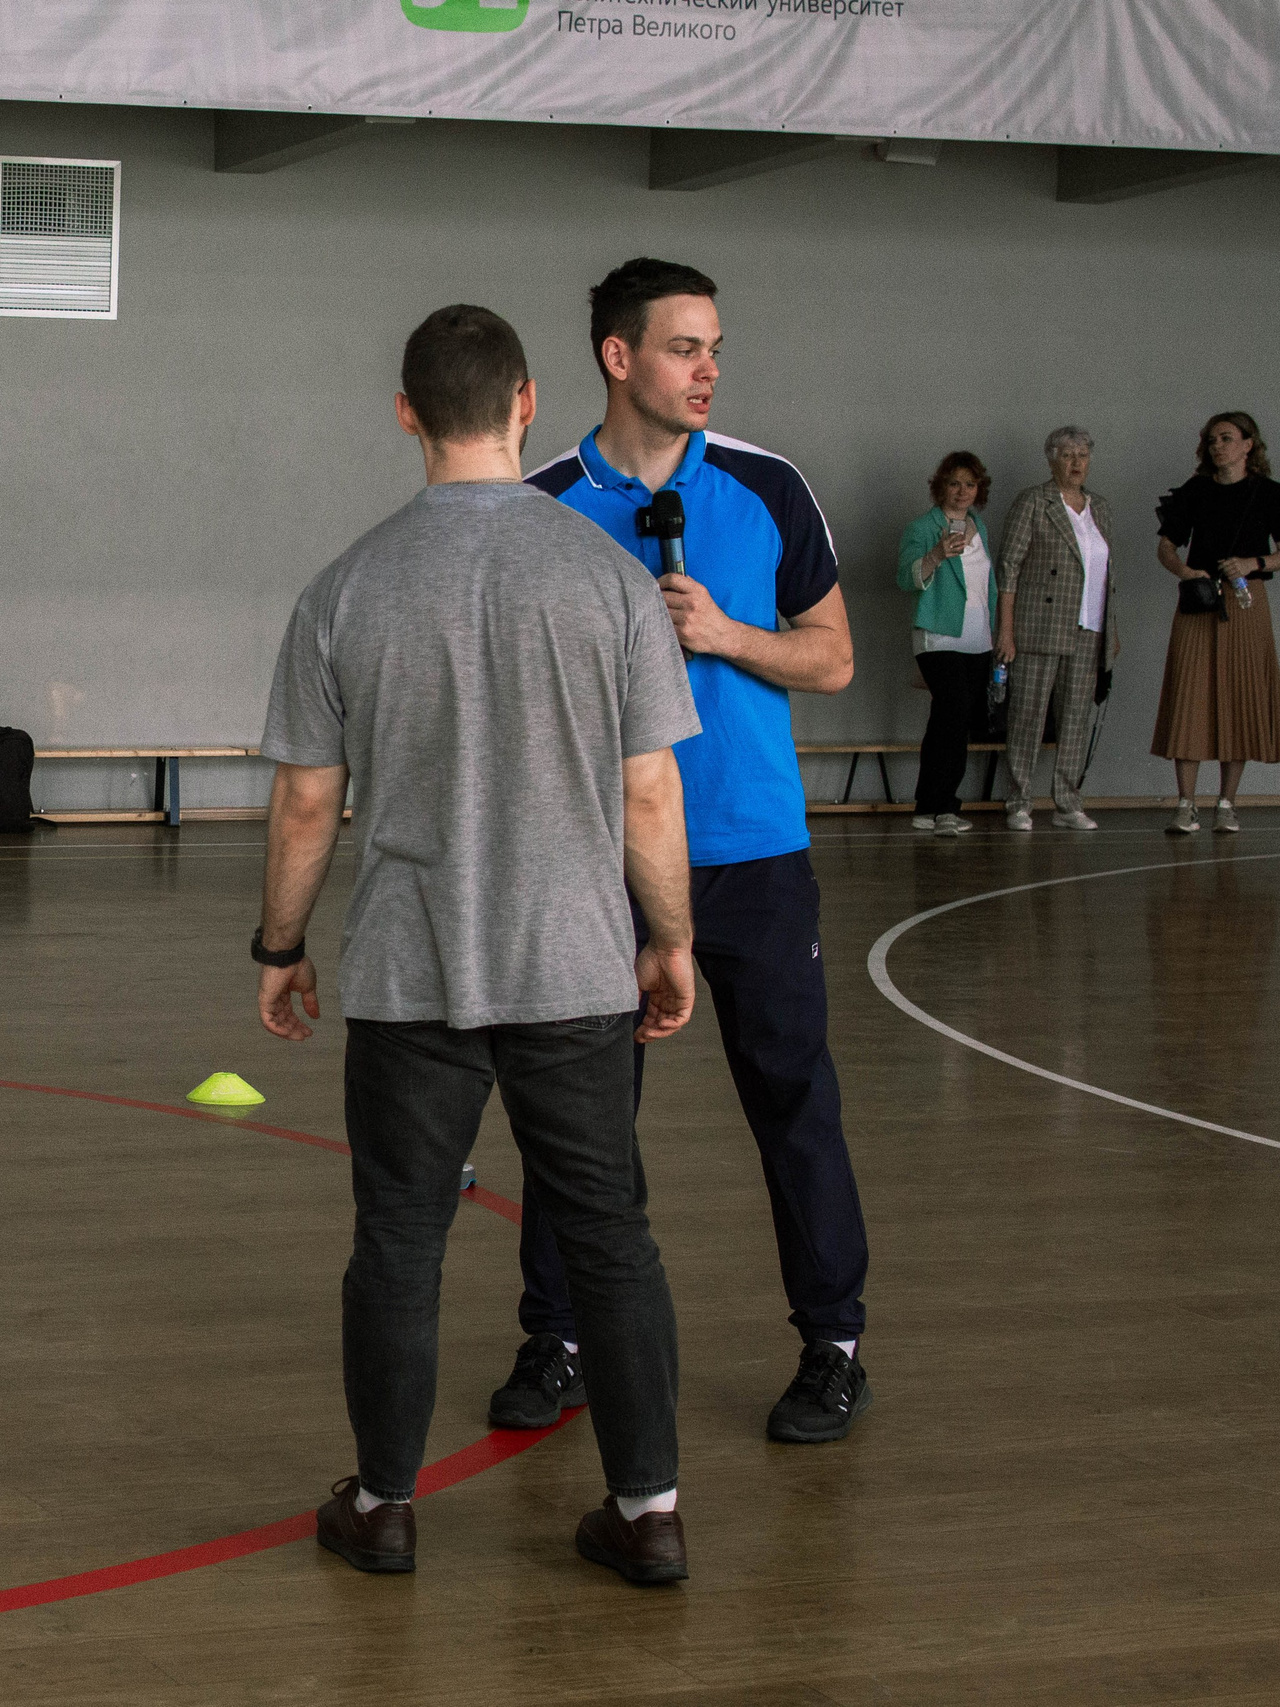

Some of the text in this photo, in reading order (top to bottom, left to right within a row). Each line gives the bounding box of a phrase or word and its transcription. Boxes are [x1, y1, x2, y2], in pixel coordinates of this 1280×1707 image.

[767, 0, 905, 20] университет
[558, 10, 737, 41] Петра Великого
